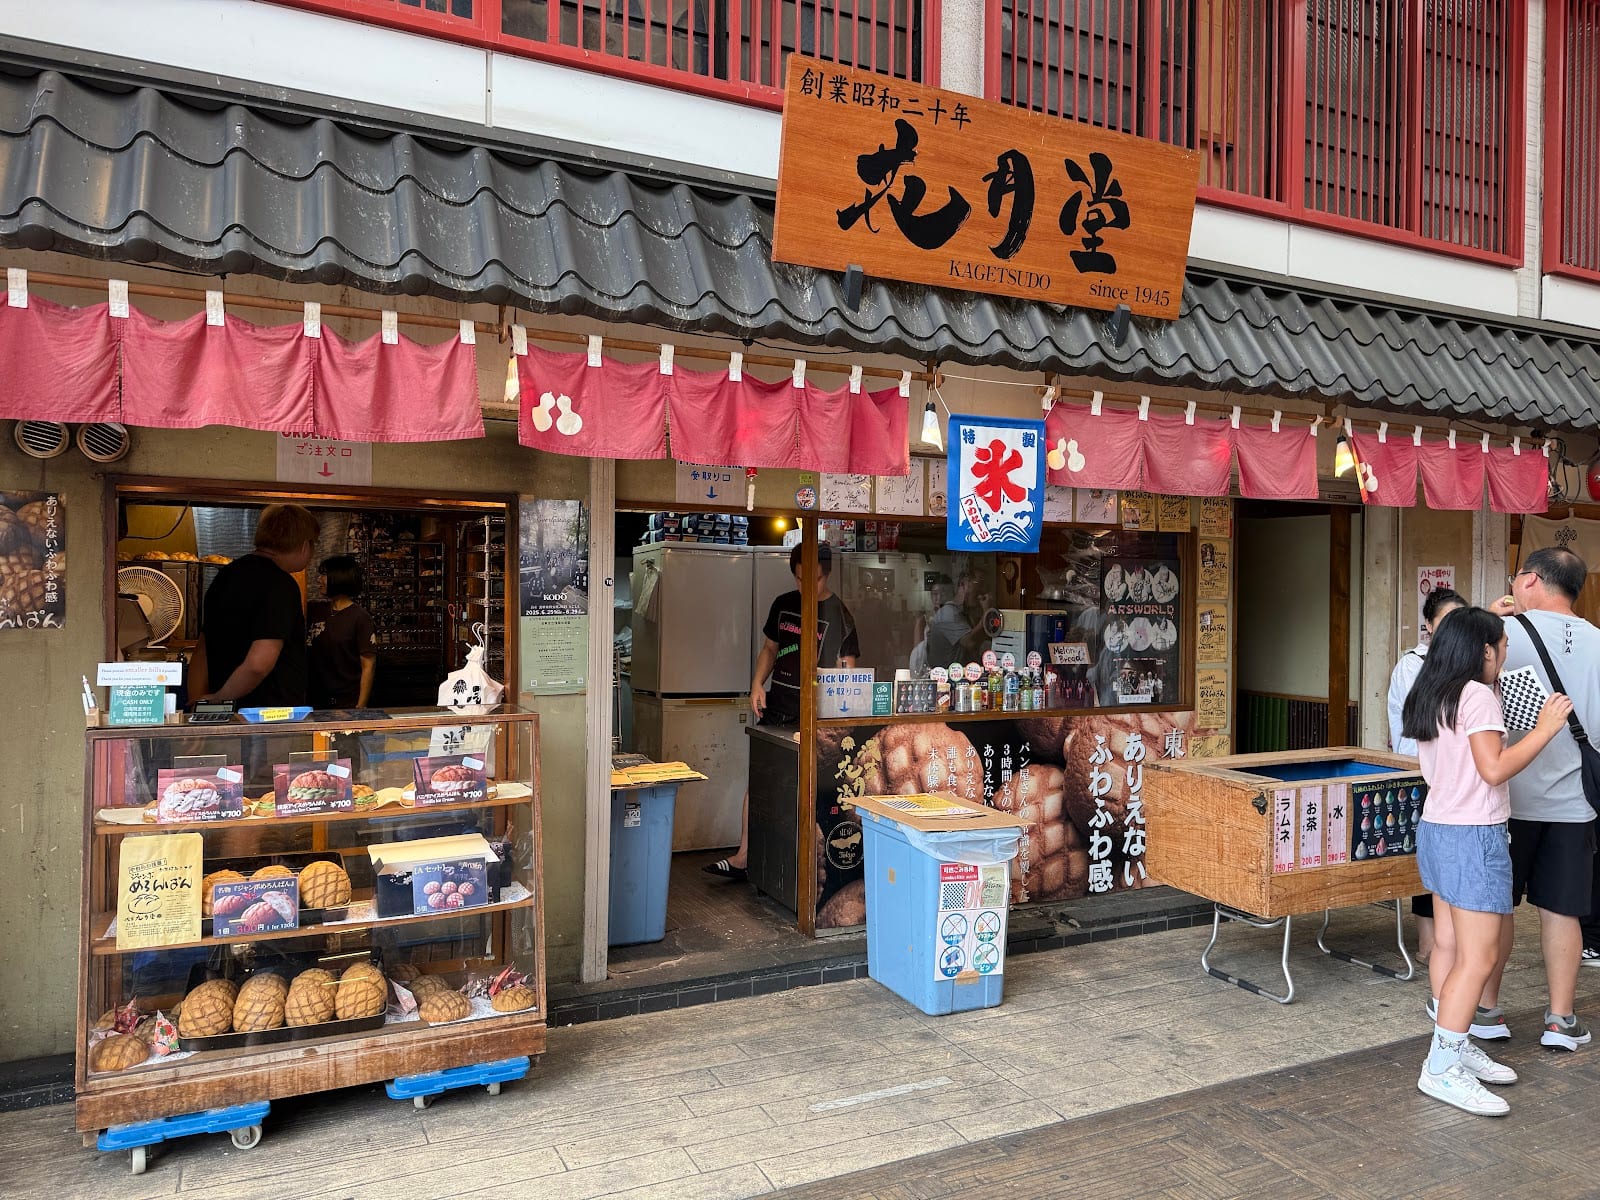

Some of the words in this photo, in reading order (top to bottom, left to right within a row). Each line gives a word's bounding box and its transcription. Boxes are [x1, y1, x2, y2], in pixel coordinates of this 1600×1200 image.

[800, 67, 971, 130] 創業昭和二十年
[836, 118, 1131, 274] 花月堂
[948, 259, 1051, 291] KAGETSUDO
[1089, 280, 1129, 301] since
[1134, 286, 1170, 306] 1945
[296, 442, 351, 457] ご注文口
[962, 428, 976, 445] 特
[970, 438, 1027, 513] 氷
[45, 495, 58, 603] ありえないふわふわ感
[1565, 623, 1573, 654] PUMA
[817, 674, 836, 683] PICK
[838, 674, 850, 683] UP
[852, 674, 872, 683] HERE
[1162, 727, 1185, 760] 東
[330, 800, 351, 808] ¥700
[463, 790, 483, 799] ¥700
[221, 810, 242, 818] ¥700
[1088, 734, 1114, 894] ふわふわ感
[1122, 732, 1146, 888] ありえない
[1280, 798, 1291, 843] ラムネ
[1306, 801, 1317, 832] お茶
[1333, 804, 1343, 819] 水
[1301, 855, 1320, 865] 200円
[129, 877, 192, 893] めろんぱん
[964, 881, 986, 908] OK
